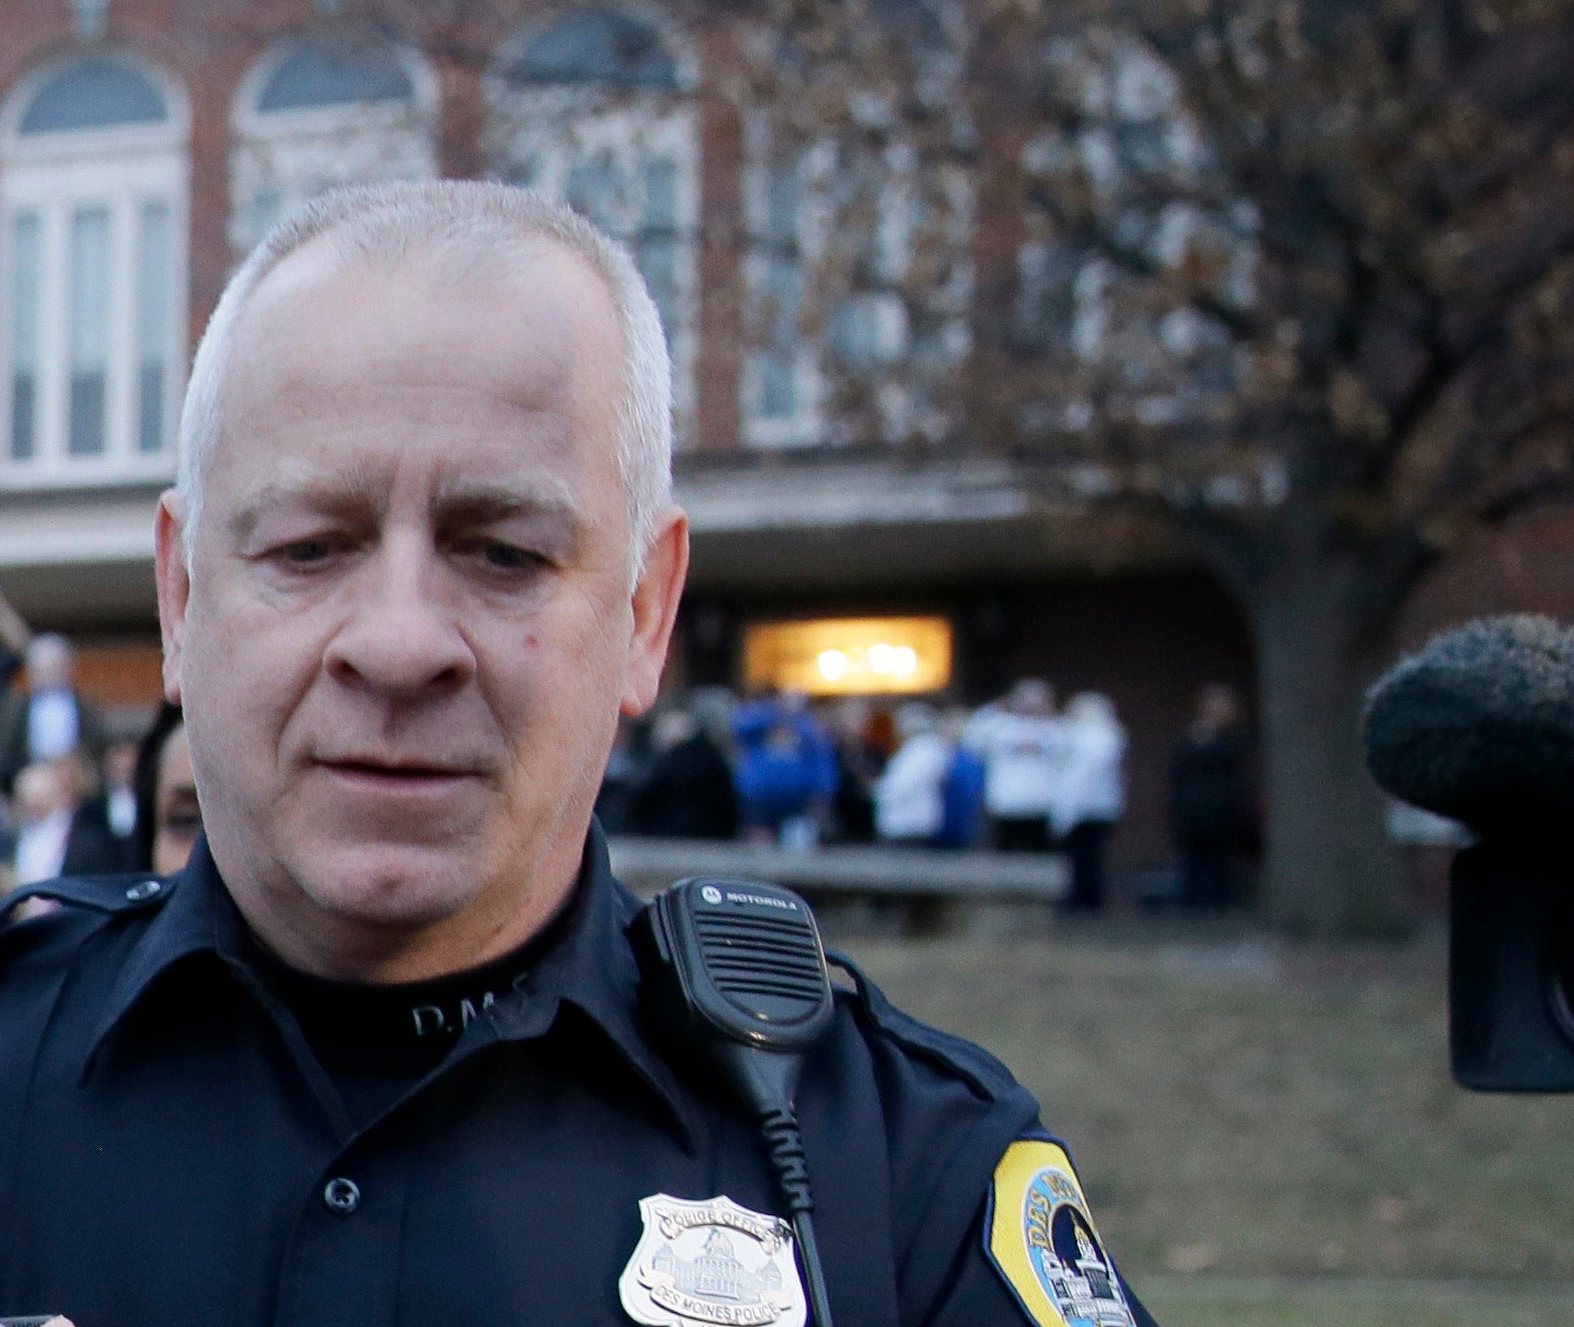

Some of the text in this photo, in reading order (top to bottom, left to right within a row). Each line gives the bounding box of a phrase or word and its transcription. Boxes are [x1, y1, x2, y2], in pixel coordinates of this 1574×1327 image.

[726, 891, 798, 911] MOTOROLA
[654, 1284, 781, 1322] DES MOINES POLICE
